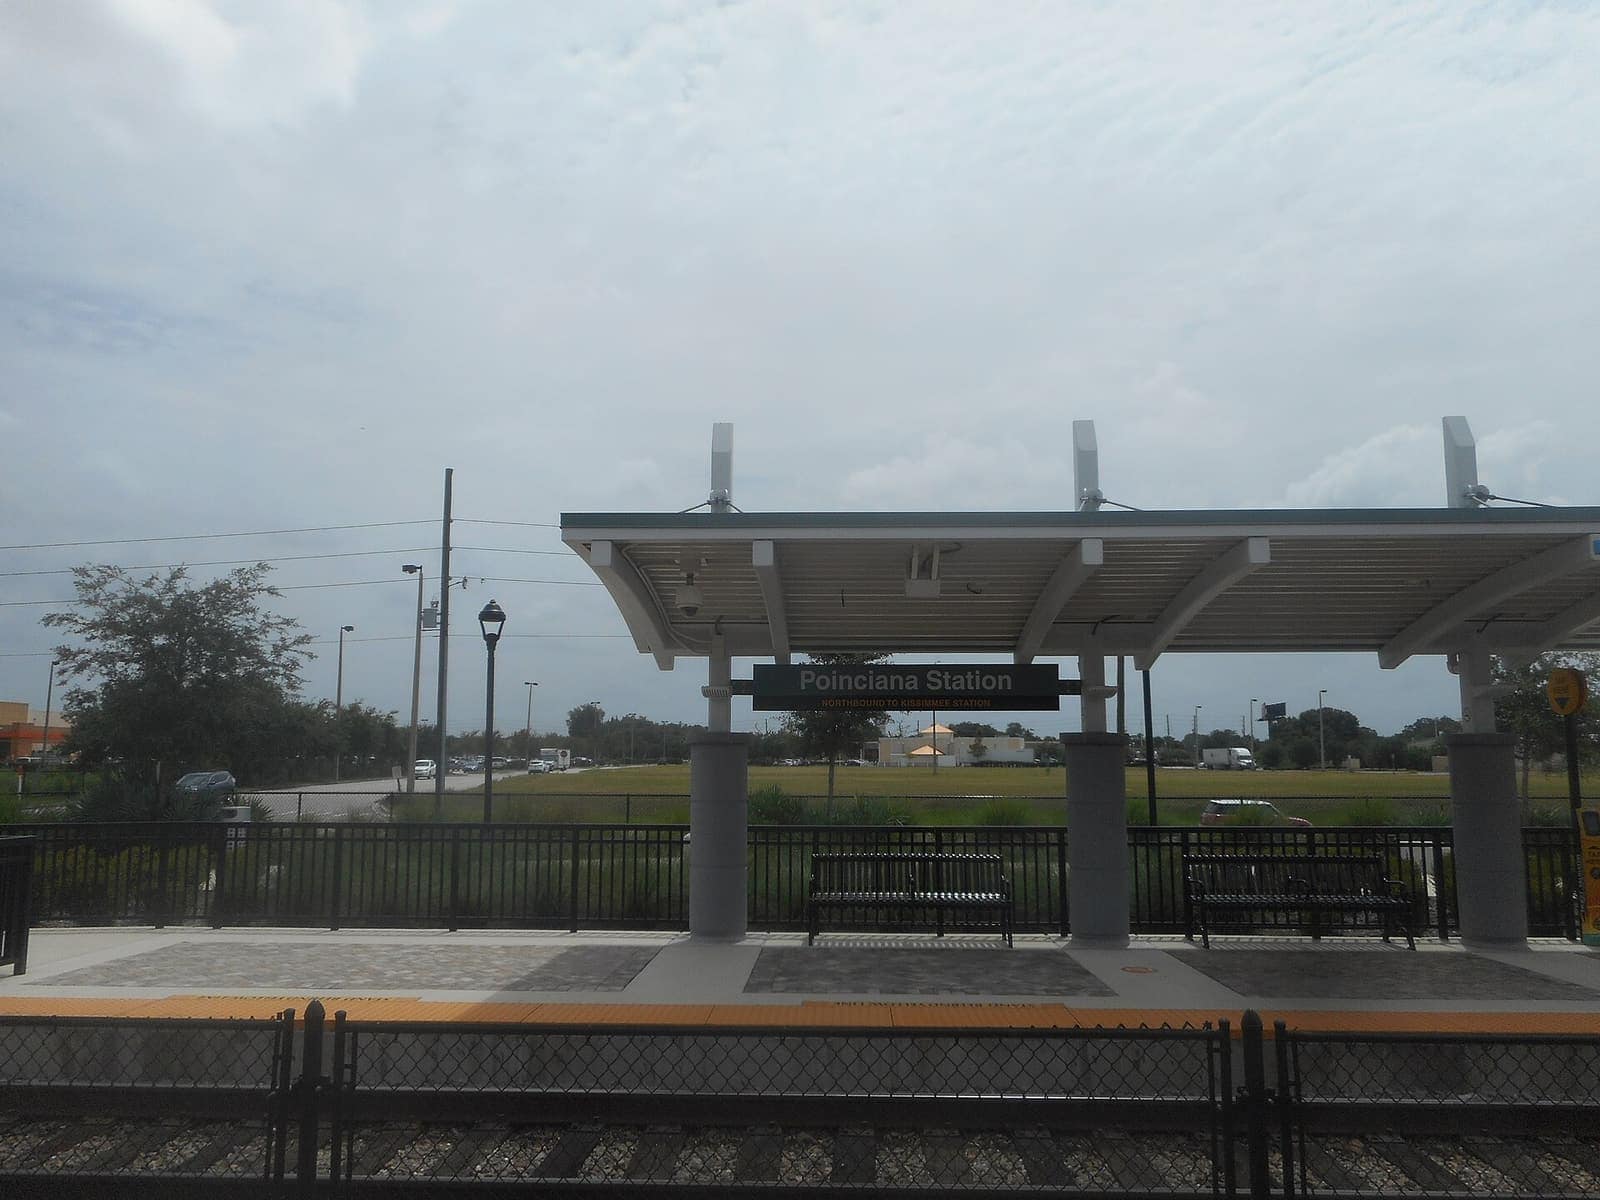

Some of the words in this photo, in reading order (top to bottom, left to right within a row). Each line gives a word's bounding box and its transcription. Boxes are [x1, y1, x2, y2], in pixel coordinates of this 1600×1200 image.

[800, 670, 919, 690] Poinciana
[926, 670, 1012, 690] Station
[953, 699, 991, 707] STATION
